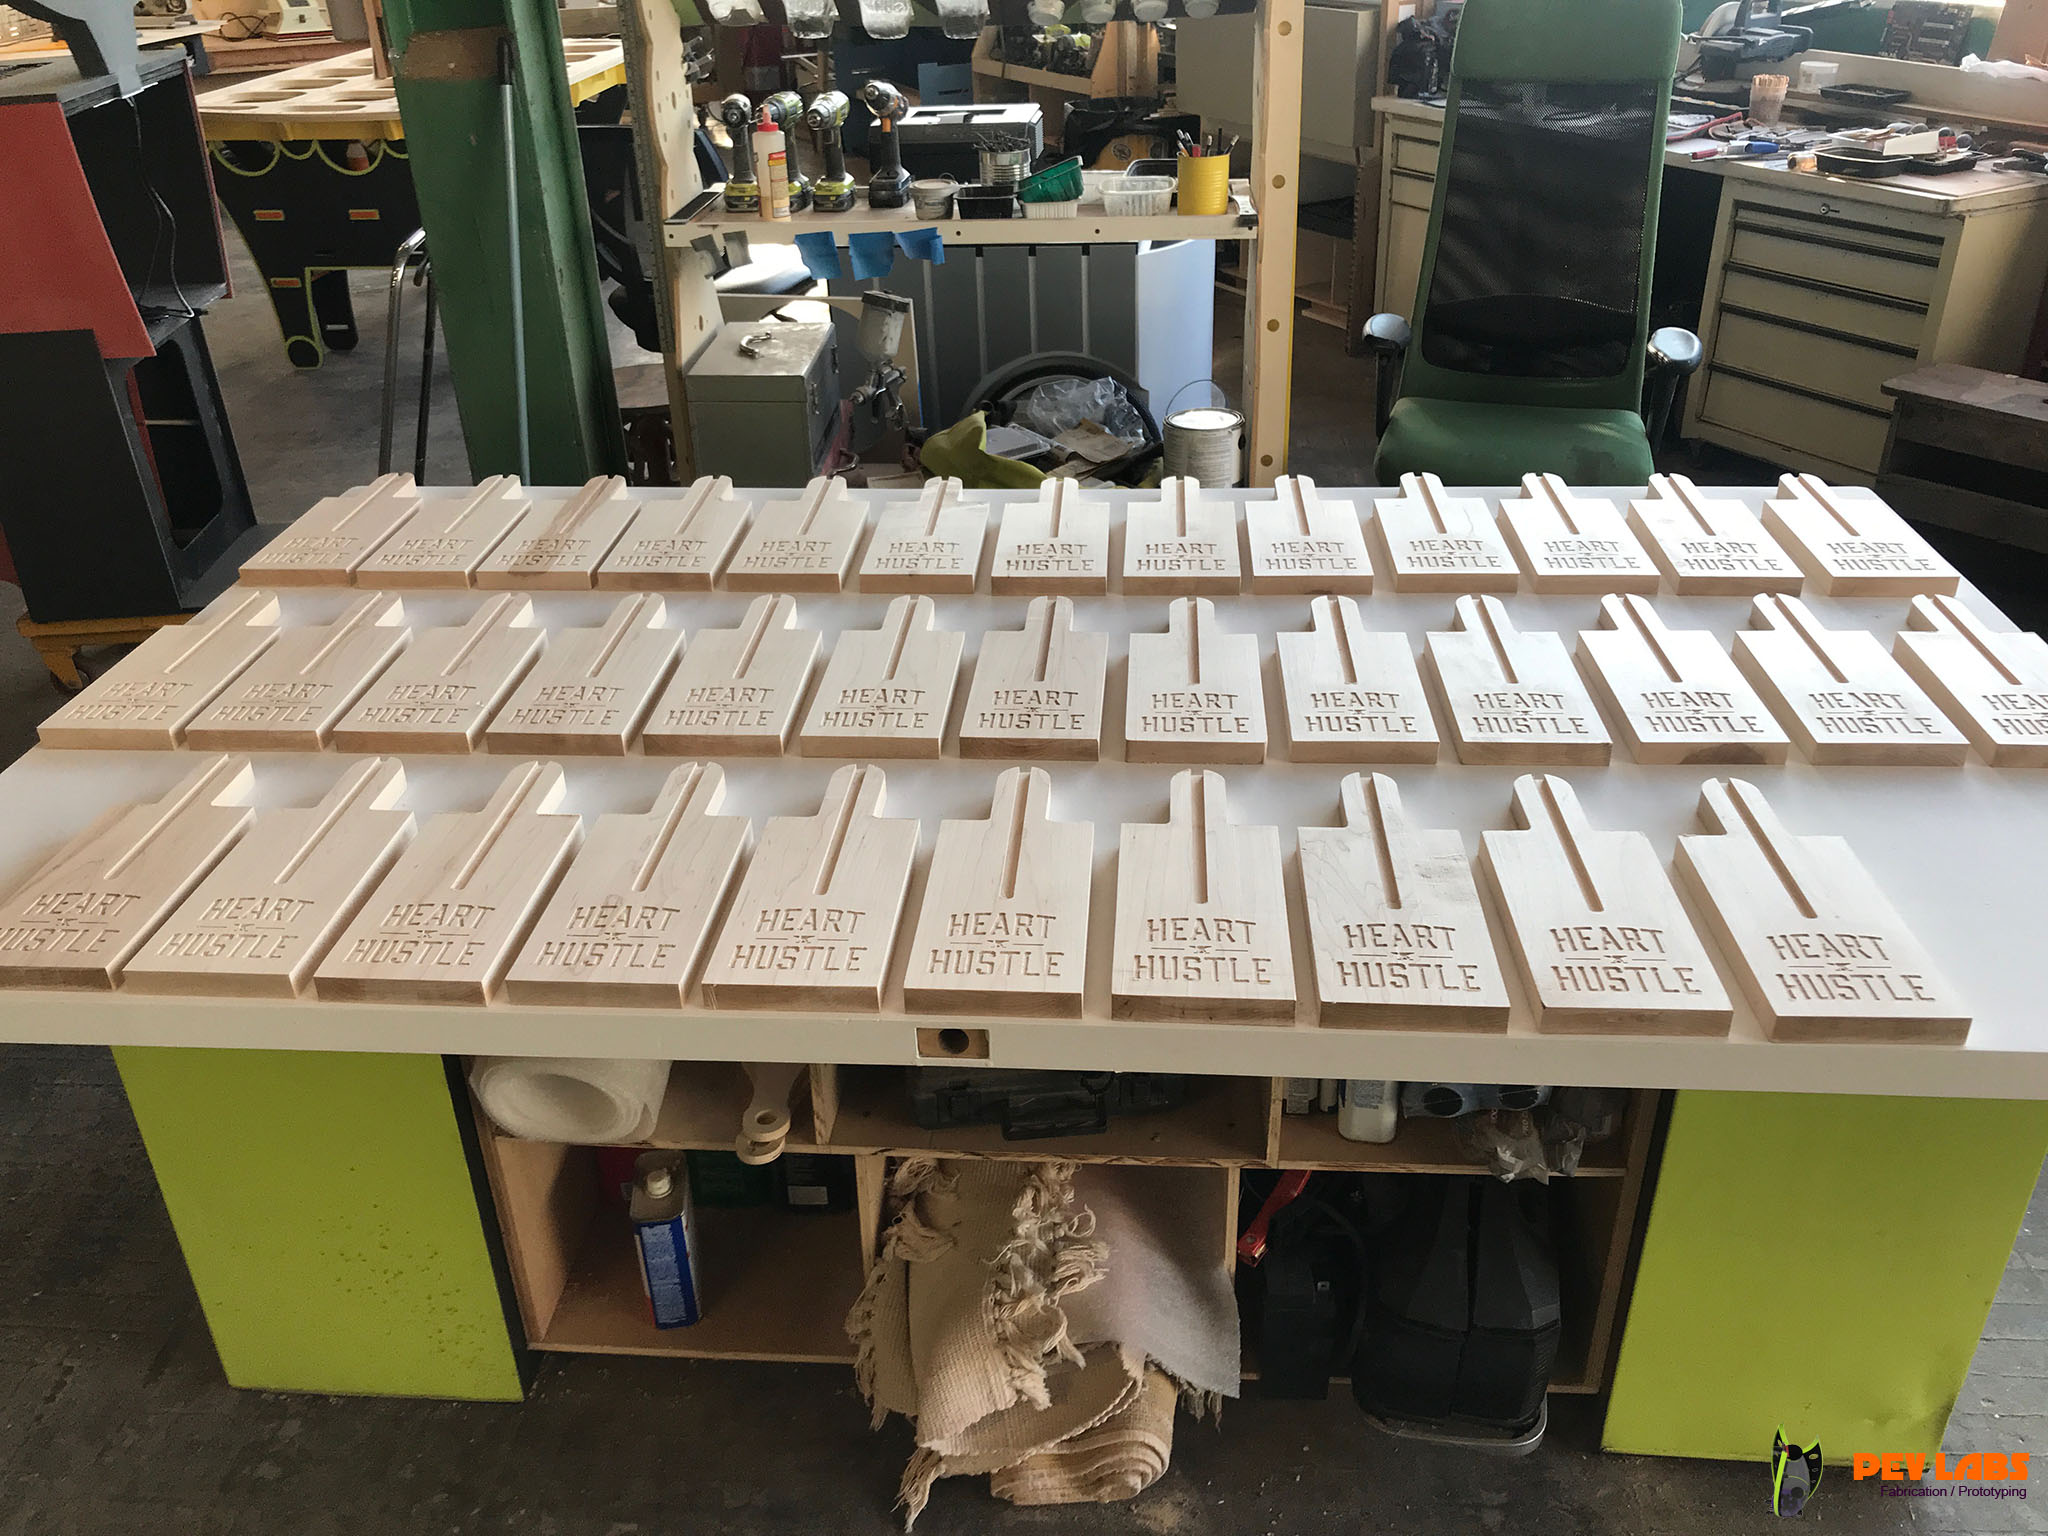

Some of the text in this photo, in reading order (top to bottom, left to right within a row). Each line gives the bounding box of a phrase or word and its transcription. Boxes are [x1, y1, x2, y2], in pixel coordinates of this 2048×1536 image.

[284, 537, 359, 548] HEART
[400, 539, 473, 549] HEART
[516, 539, 591, 551] HEART
[633, 540, 707, 551] HEART
[760, 541, 832, 552] HEART
[889, 542, 960, 553] HEART
[1017, 543, 1087, 555] HEART
[1146, 543, 1217, 554] HEART
[1272, 542, 1344, 553] HEART
[1409, 540, 1483, 551] HEART
[1543, 541, 1619, 554] HEART
[1681, 542, 1758, 555] HEART
[1825, 542, 1905, 555] HEART
[259, 553, 349, 563] HUSTLE
[376, 554, 468, 565] HUSTLE
[496, 554, 587, 566] HUSTLE
[616, 556, 705, 567] HUSTLE
[744, 556, 832, 568] HUSTLE
[875, 558, 963, 569] HUSTLE
[1006, 560, 1094, 571] HUSTLE
[1137, 559, 1225, 570] HUSTLE
[1266, 558, 1357, 569] HUSTLE
[1407, 556, 1502, 567] HUSTLE
[1544, 557, 1640, 569] HUSTLE
[1683, 558, 1783, 570] HUSTLE
[1831, 558, 1936, 571] HUSTLE
[99, 681, 192, 697] HEART
[242, 683, 333, 698] HEART
[388, 685, 476, 700] HEART
[534, 686, 624, 701] HEART
[686, 687, 774, 702] HEART
[840, 688, 926, 704] HEART
[993, 690, 1079, 706] HEART
[1152, 692, 1239, 709] HEART
[1311, 691, 1399, 709] HEART
[1473, 693, 1564, 710] HEART
[1641, 692, 1734, 708] HEART
[1808, 693, 1906, 709] HEART
[64, 705, 180, 720] HUSTLE
[209, 705, 323, 722] HUSTLE
[358, 707, 469, 723] HUSTLE
[508, 708, 620, 725] HUSTLE
[664, 710, 774, 726] HUSTLE
[820, 711, 929, 728] HUSTLE
[978, 712, 1085, 730] HUSTLE
[1142, 716, 1250, 733] HUSTLE
[1305, 716, 1417, 733] HUSTLE
[1473, 717, 1589, 734] HUSTLE
[1645, 716, 1764, 732] HUSTLE
[1816, 717, 1941, 734] HUSTLE
[24, 892, 140, 916] HEART
[200, 897, 314, 922] HEART
[380, 904, 495, 928] HEART
[567, 905, 680, 929] HEART
[756, 909, 866, 934] HEART
[948, 912, 1056, 938] HEART
[1147, 918, 1256, 944] HEART
[157, 933, 299, 958] HUSTLE
[1343, 924, 1456, 951] HEART
[1550, 926, 1666, 953] HEART
[343, 939, 485, 966] HUSTLE
[534, 941, 676, 968] HUSTLE
[1767, 934, 1890, 961] HEART
[729, 945, 867, 972] HUSTLE
[928, 950, 1064, 977] HUSTLE
[1133, 955, 1272, 985] HUSTLE
[1337, 961, 1482, 991] HUSTLE
[1551, 966, 1703, 995] HUSTLE
[1775, 974, 1936, 1001] HUSTLE
